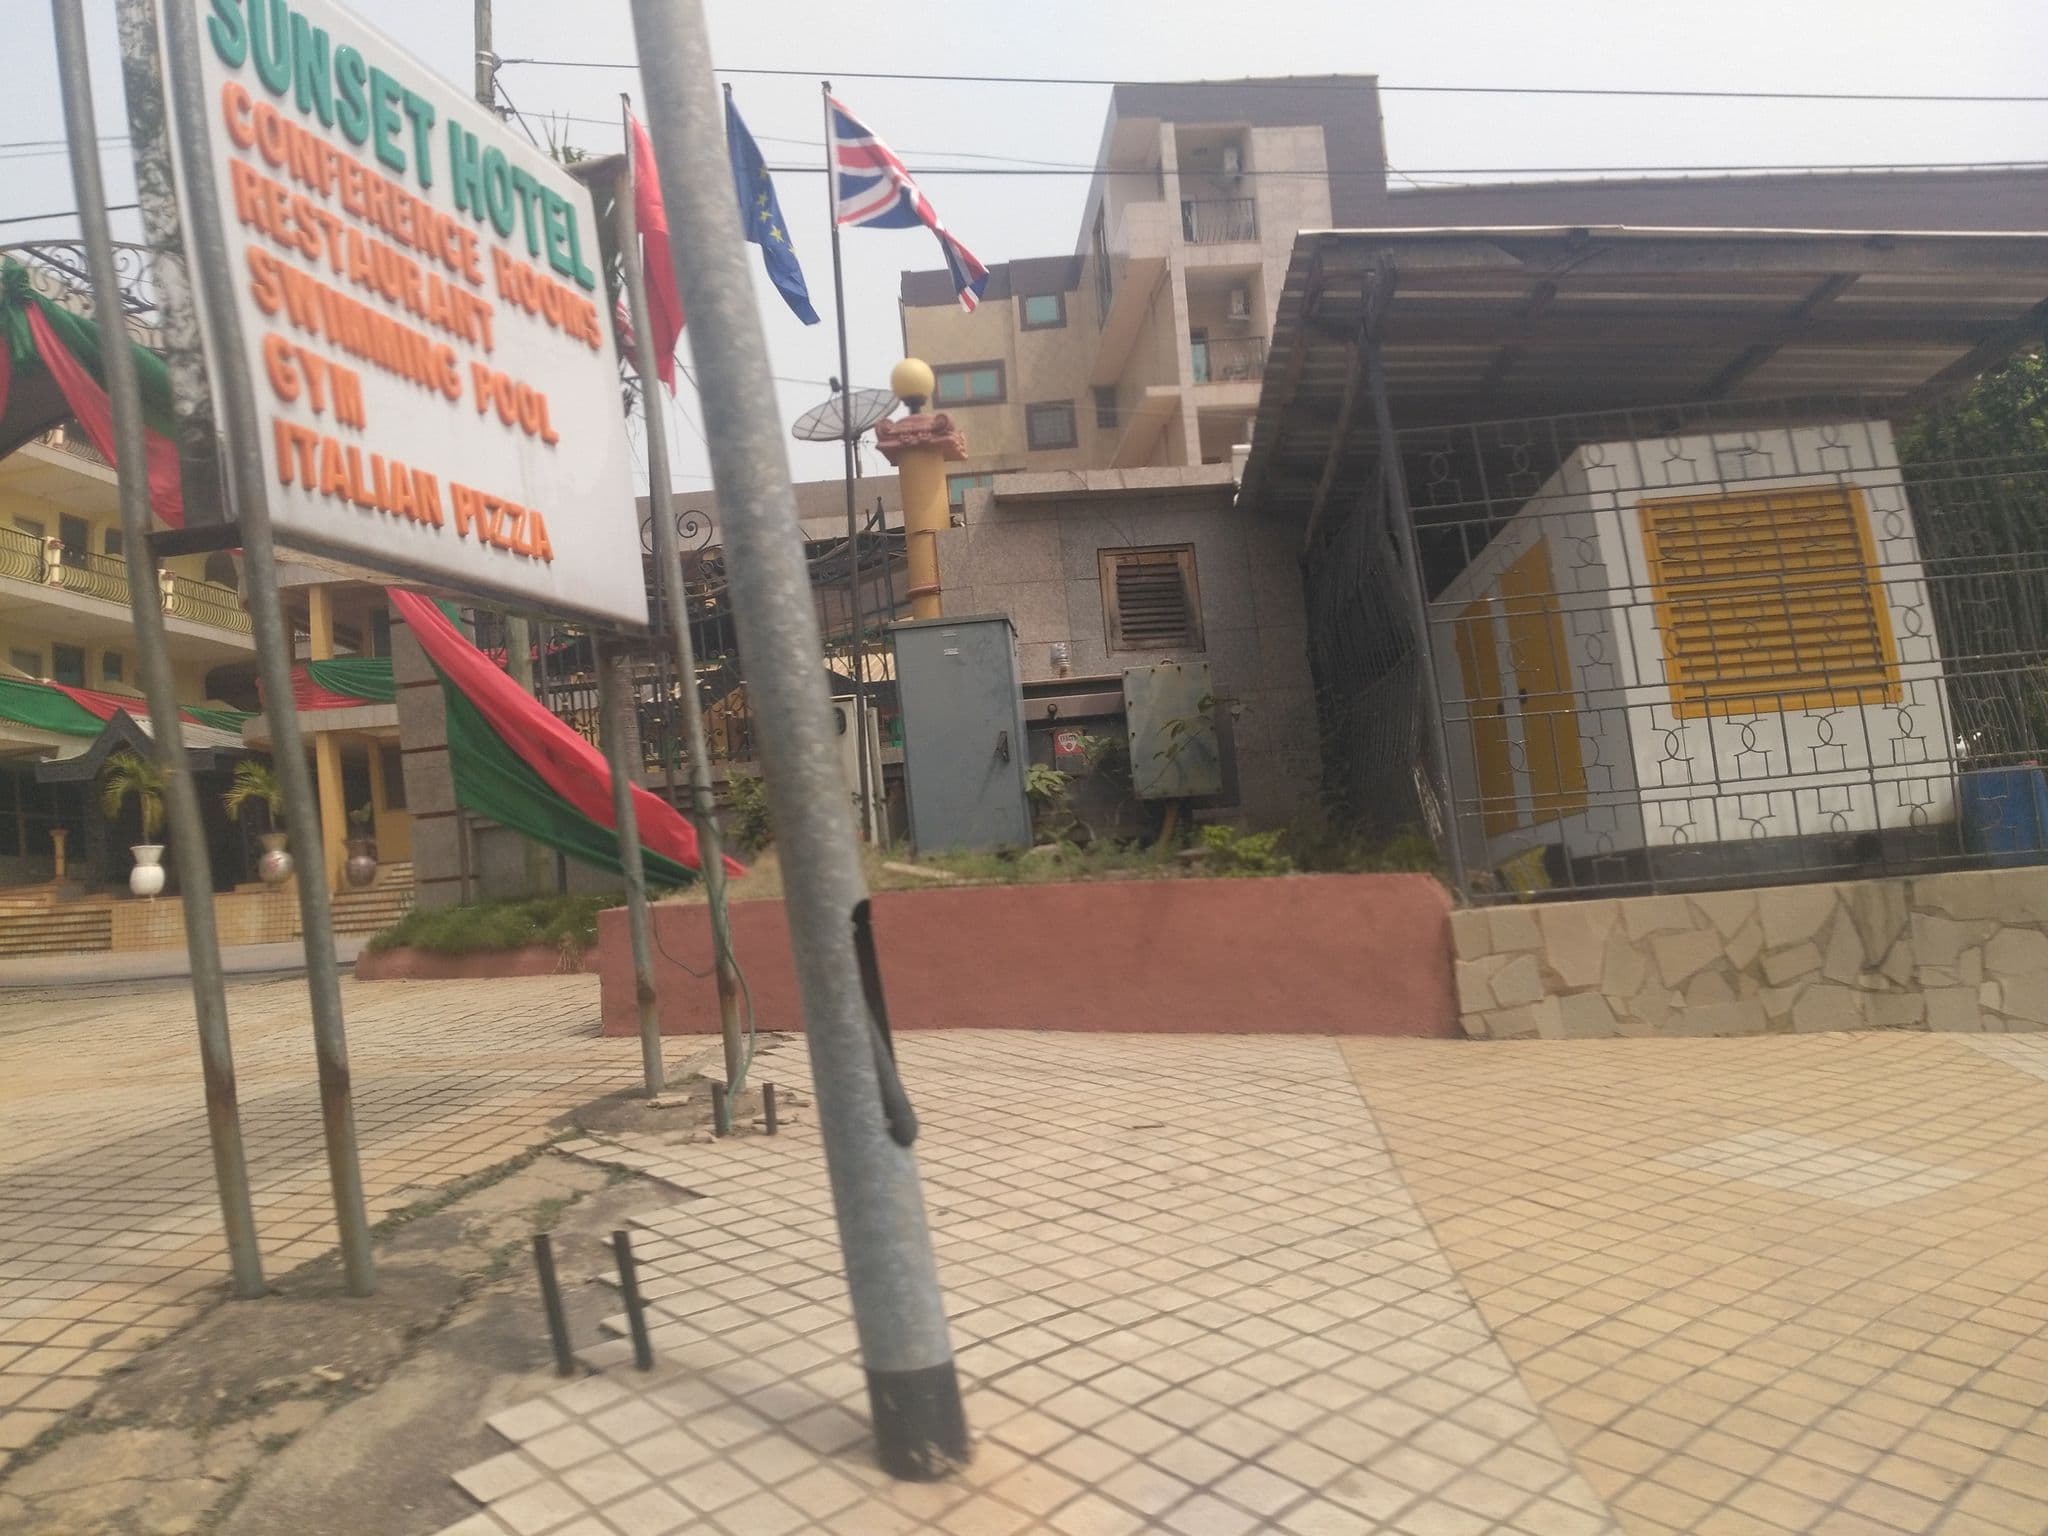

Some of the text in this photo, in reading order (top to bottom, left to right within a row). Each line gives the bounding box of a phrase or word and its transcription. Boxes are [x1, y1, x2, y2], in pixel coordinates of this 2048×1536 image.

[208, 0, 595, 291] SUNSET HOTEL
[222, 80, 602, 351] CONFERENCE ROOMS
[229, 159, 494, 353] RESTAURANT
[246, 246, 559, 446] SWIMMING POOL
[263, 332, 366, 431] GYM
[273, 419, 554, 563] ITALIAN PIZZA
